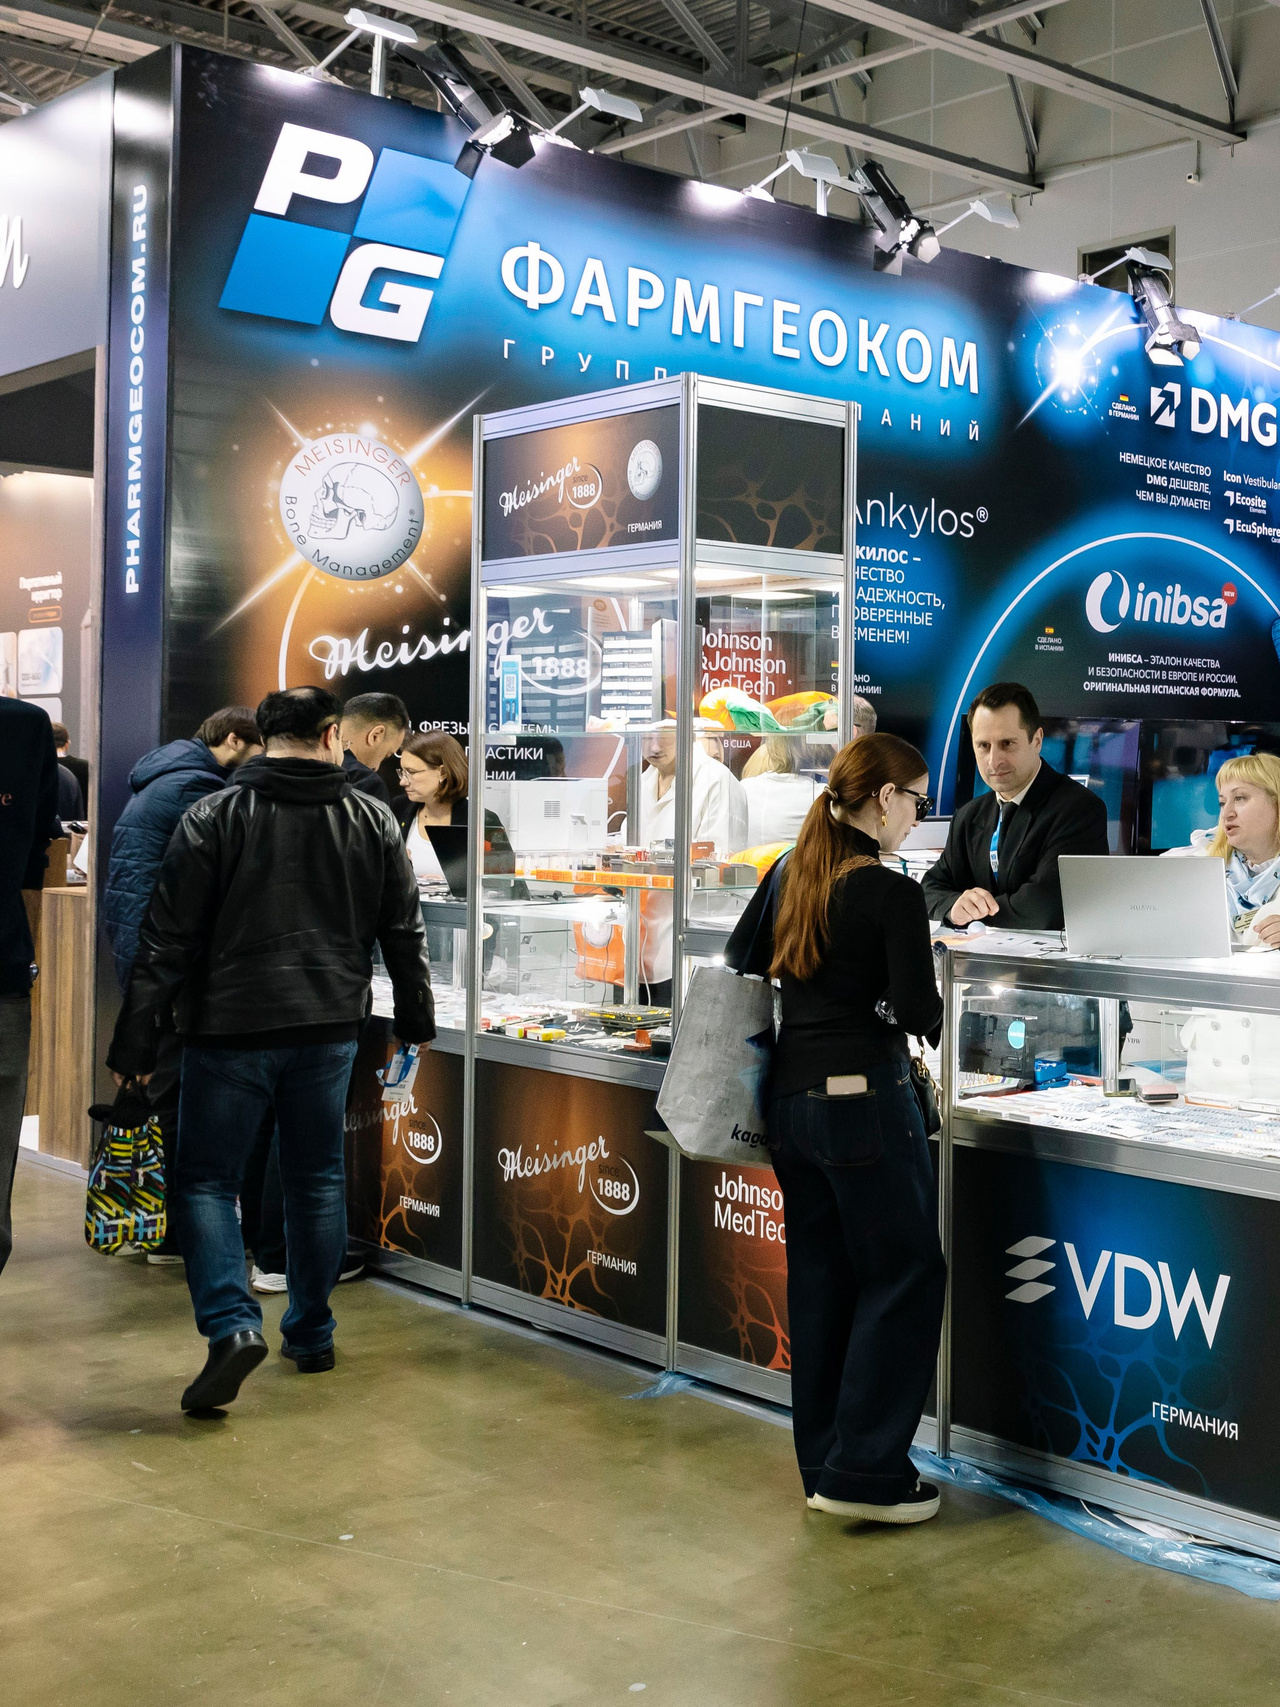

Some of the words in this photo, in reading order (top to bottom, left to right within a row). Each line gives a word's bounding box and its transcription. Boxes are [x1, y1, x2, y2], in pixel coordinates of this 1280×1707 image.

[501, 241, 980, 394] ФАРМГЕОКОМ
[126, 183, 148, 594] PHARMGEOCOM.RU
[503, 339, 668, 380] ГРУПП
[856, 402, 980, 441] АНИЙ
[1111, 401, 1137, 413] СДЕЛАНО
[1113, 410, 1140, 421] ГЕРМАНИИ
[1190, 386, 1278, 447] DMG
[294, 438, 411, 487] MEISINGER
[1119, 452, 1167, 470] НЕМЕЦКОЕ
[1168, 460, 1212, 477] КАЧЕСТВО
[499, 456, 581, 517] Meisinger
[1146, 474, 1168, 487] DMG
[1168, 477, 1212, 495] ДЕШЕВЛЕ,
[1223, 470, 1242, 484] Icon
[572, 483, 596, 499] 1888
[1136, 489, 1154, 502] ЧЕМ
[1155, 491, 1168, 504] ВЫ
[1169, 494, 1211, 510] ДУМАЕТЕ!
[1235, 492, 1267, 508] Ecosite
[285, 495, 307, 545] Bone
[627, 520, 663, 533] ГЕРМАНИЯ
[856, 545, 908, 563] КИЛОС
[856, 565, 905, 584] ЧЕСТВО
[857, 586, 945, 610] АДЕЖНОСТЬ,
[1223, 590, 1235, 598] NEW
[831, 605, 933, 626] ПОВЕРЕННЫЕ
[1134, 583, 1228, 629] inibsa
[831, 625, 910, 645] ВЕМЕНЕМ!
[1037, 636, 1062, 645] СДЕЛАНО
[1039, 644, 1064, 652] ИСПАНИИ
[531, 656, 591, 679] 1888
[1108, 652, 1142, 664] ИНИБСА
[1150, 655, 1182, 666] ЭТАЛОН
[1183, 657, 1220, 669] КАЧЕСТВА
[1088, 666, 1094, 676] И
[1096, 667, 1160, 680] БЕЗОПАСНОСТИ
[1162, 670, 1167, 680] В
[1168, 671, 1197, 682] ЕВРОПЕ
[1199, 673, 1204, 682] И
[1205, 673, 1238, 684] РОССИИ.
[1083, 681, 1150, 694] ОРИГИНАЛЬНАЯ
[1152, 685, 1199, 697] ИСПАНСКАЯ
[1200, 686, 1241, 698] ФОРМУЛА.
[488, 723, 559, 734] СТЕМЫ
[731, 740, 751, 749] США
[408, 1131, 434, 1152] 1888
[498, 1135, 610, 1194] Meisinger
[597, 1177, 631, 1201] 1888
[714, 1172, 783, 1211] Johnso
[399, 1195, 440, 1217] ГЕРМАНИЯ
[714, 1204, 786, 1245] MedTec
[586, 1249, 637, 1276] ГЕРМАНИЯ
[1063, 1242, 1231, 1350] VDW
[1152, 1401, 1239, 1441] ГЕРМАНИЯ
